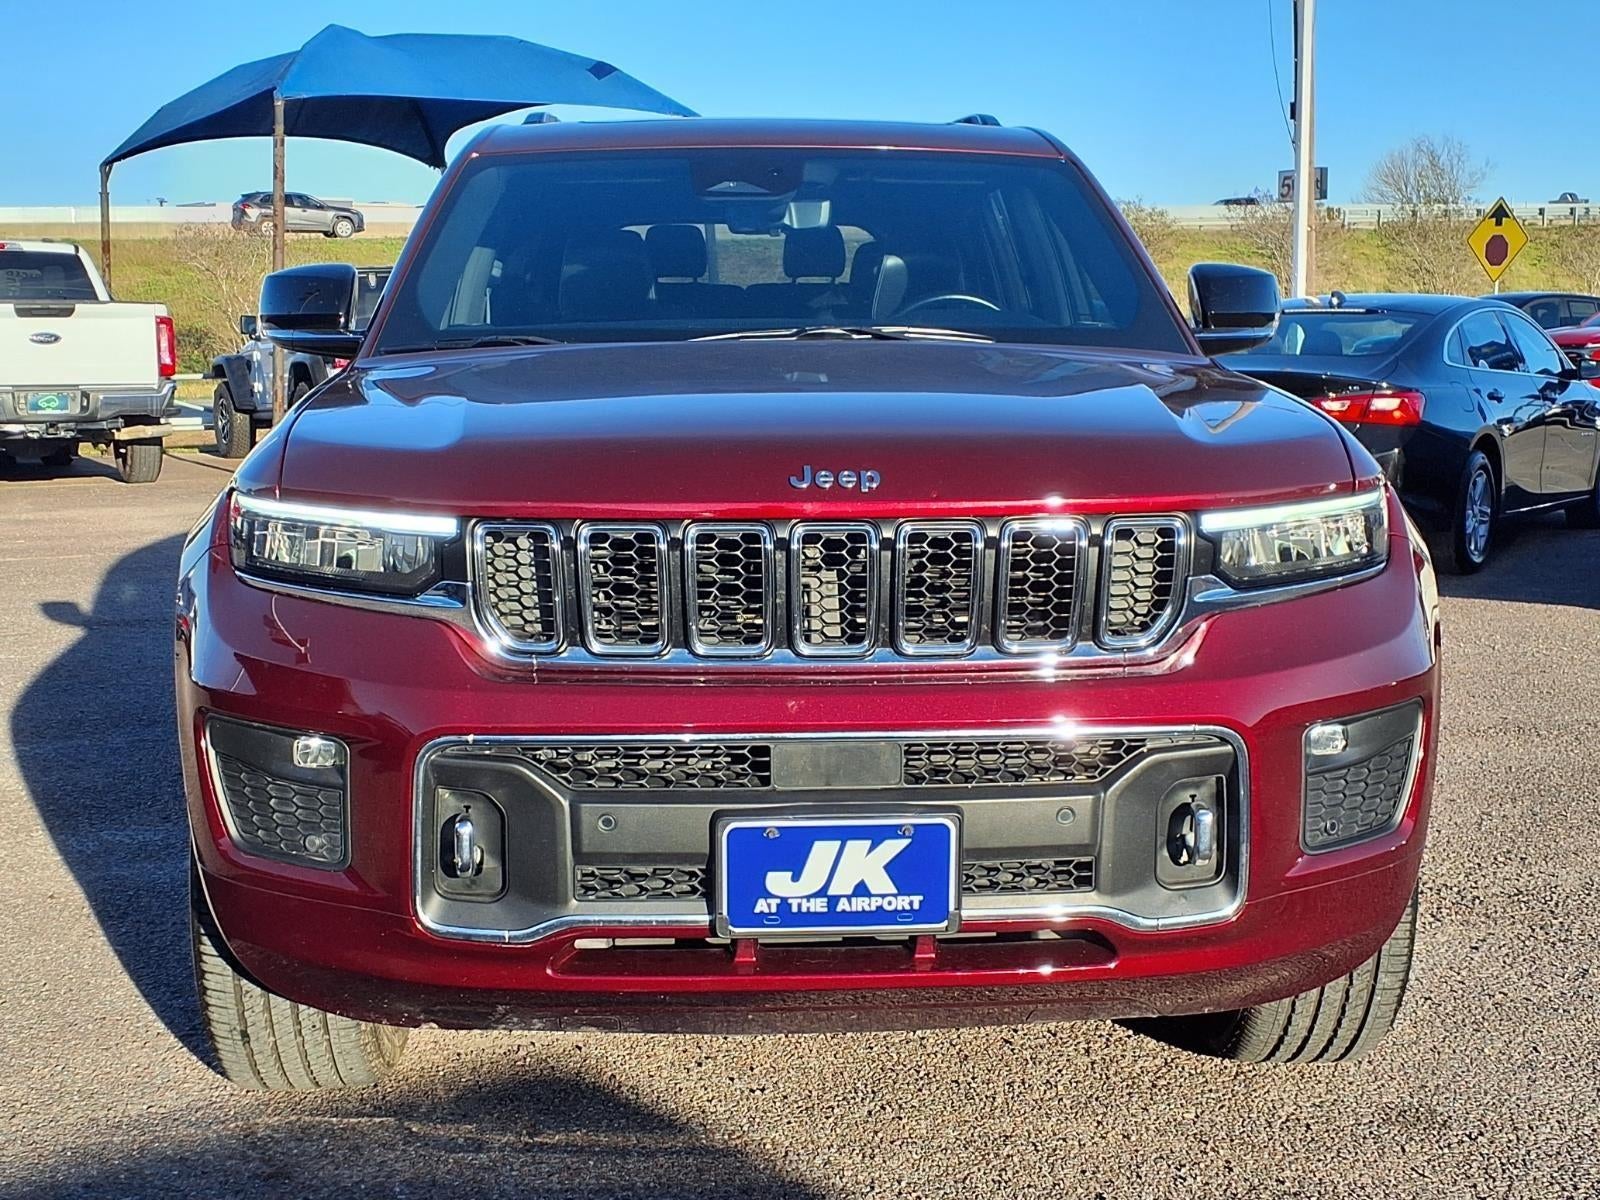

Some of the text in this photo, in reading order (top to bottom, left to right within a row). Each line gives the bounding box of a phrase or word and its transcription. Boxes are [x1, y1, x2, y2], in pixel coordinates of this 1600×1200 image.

[789, 464, 881, 493] Jeep
[765, 839, 912, 897] JK
[754, 895, 923, 913] AT THE AIRPORT
